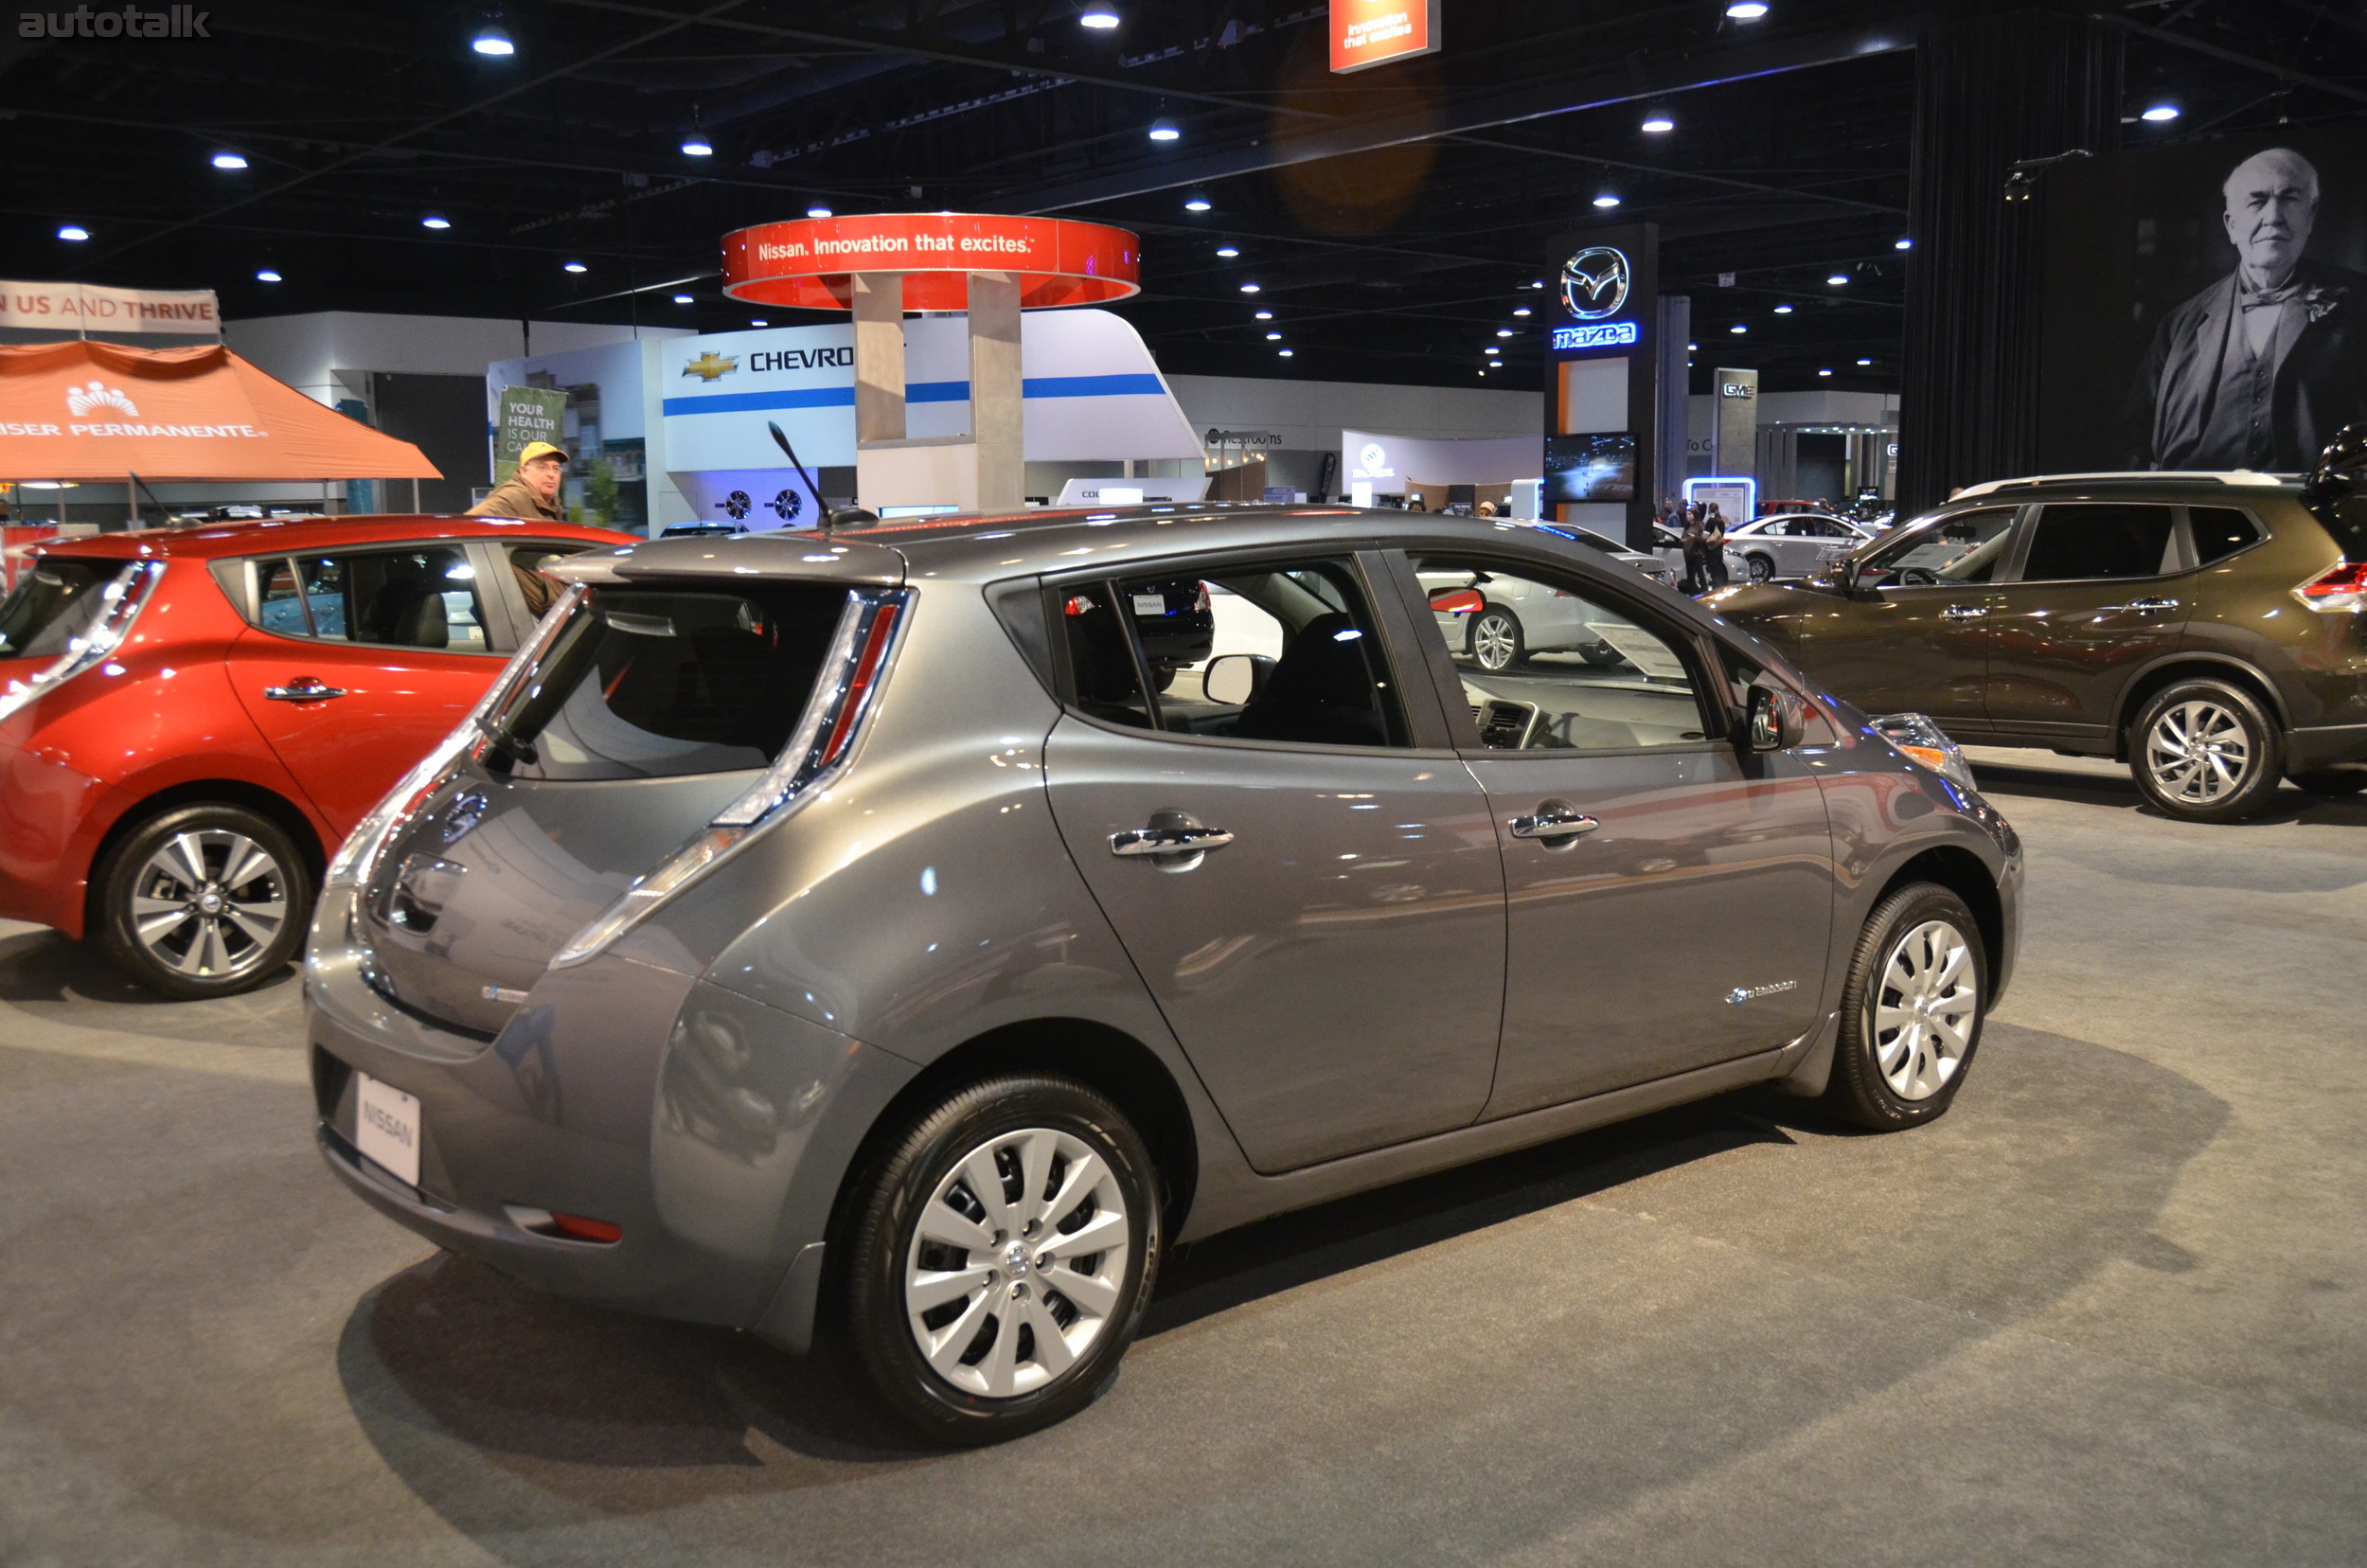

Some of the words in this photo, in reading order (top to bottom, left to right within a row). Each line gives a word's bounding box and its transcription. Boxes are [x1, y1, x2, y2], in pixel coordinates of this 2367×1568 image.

[1344, 32, 1367, 49] that
[758, 243, 810, 261] Nissan.
[814, 234, 908, 256] Innovation
[915, 234, 954, 251] that
[17, 296, 51, 315] US
[60, 297, 116, 318] AND
[122, 301, 214, 321] THRIVE
[508, 402, 544, 417] YOUR
[507, 416, 555, 430] HEALTH
[507, 428, 518, 439] IS
[520, 429, 547, 442] OUR
[364, 1099, 414, 1149] NISSAN
